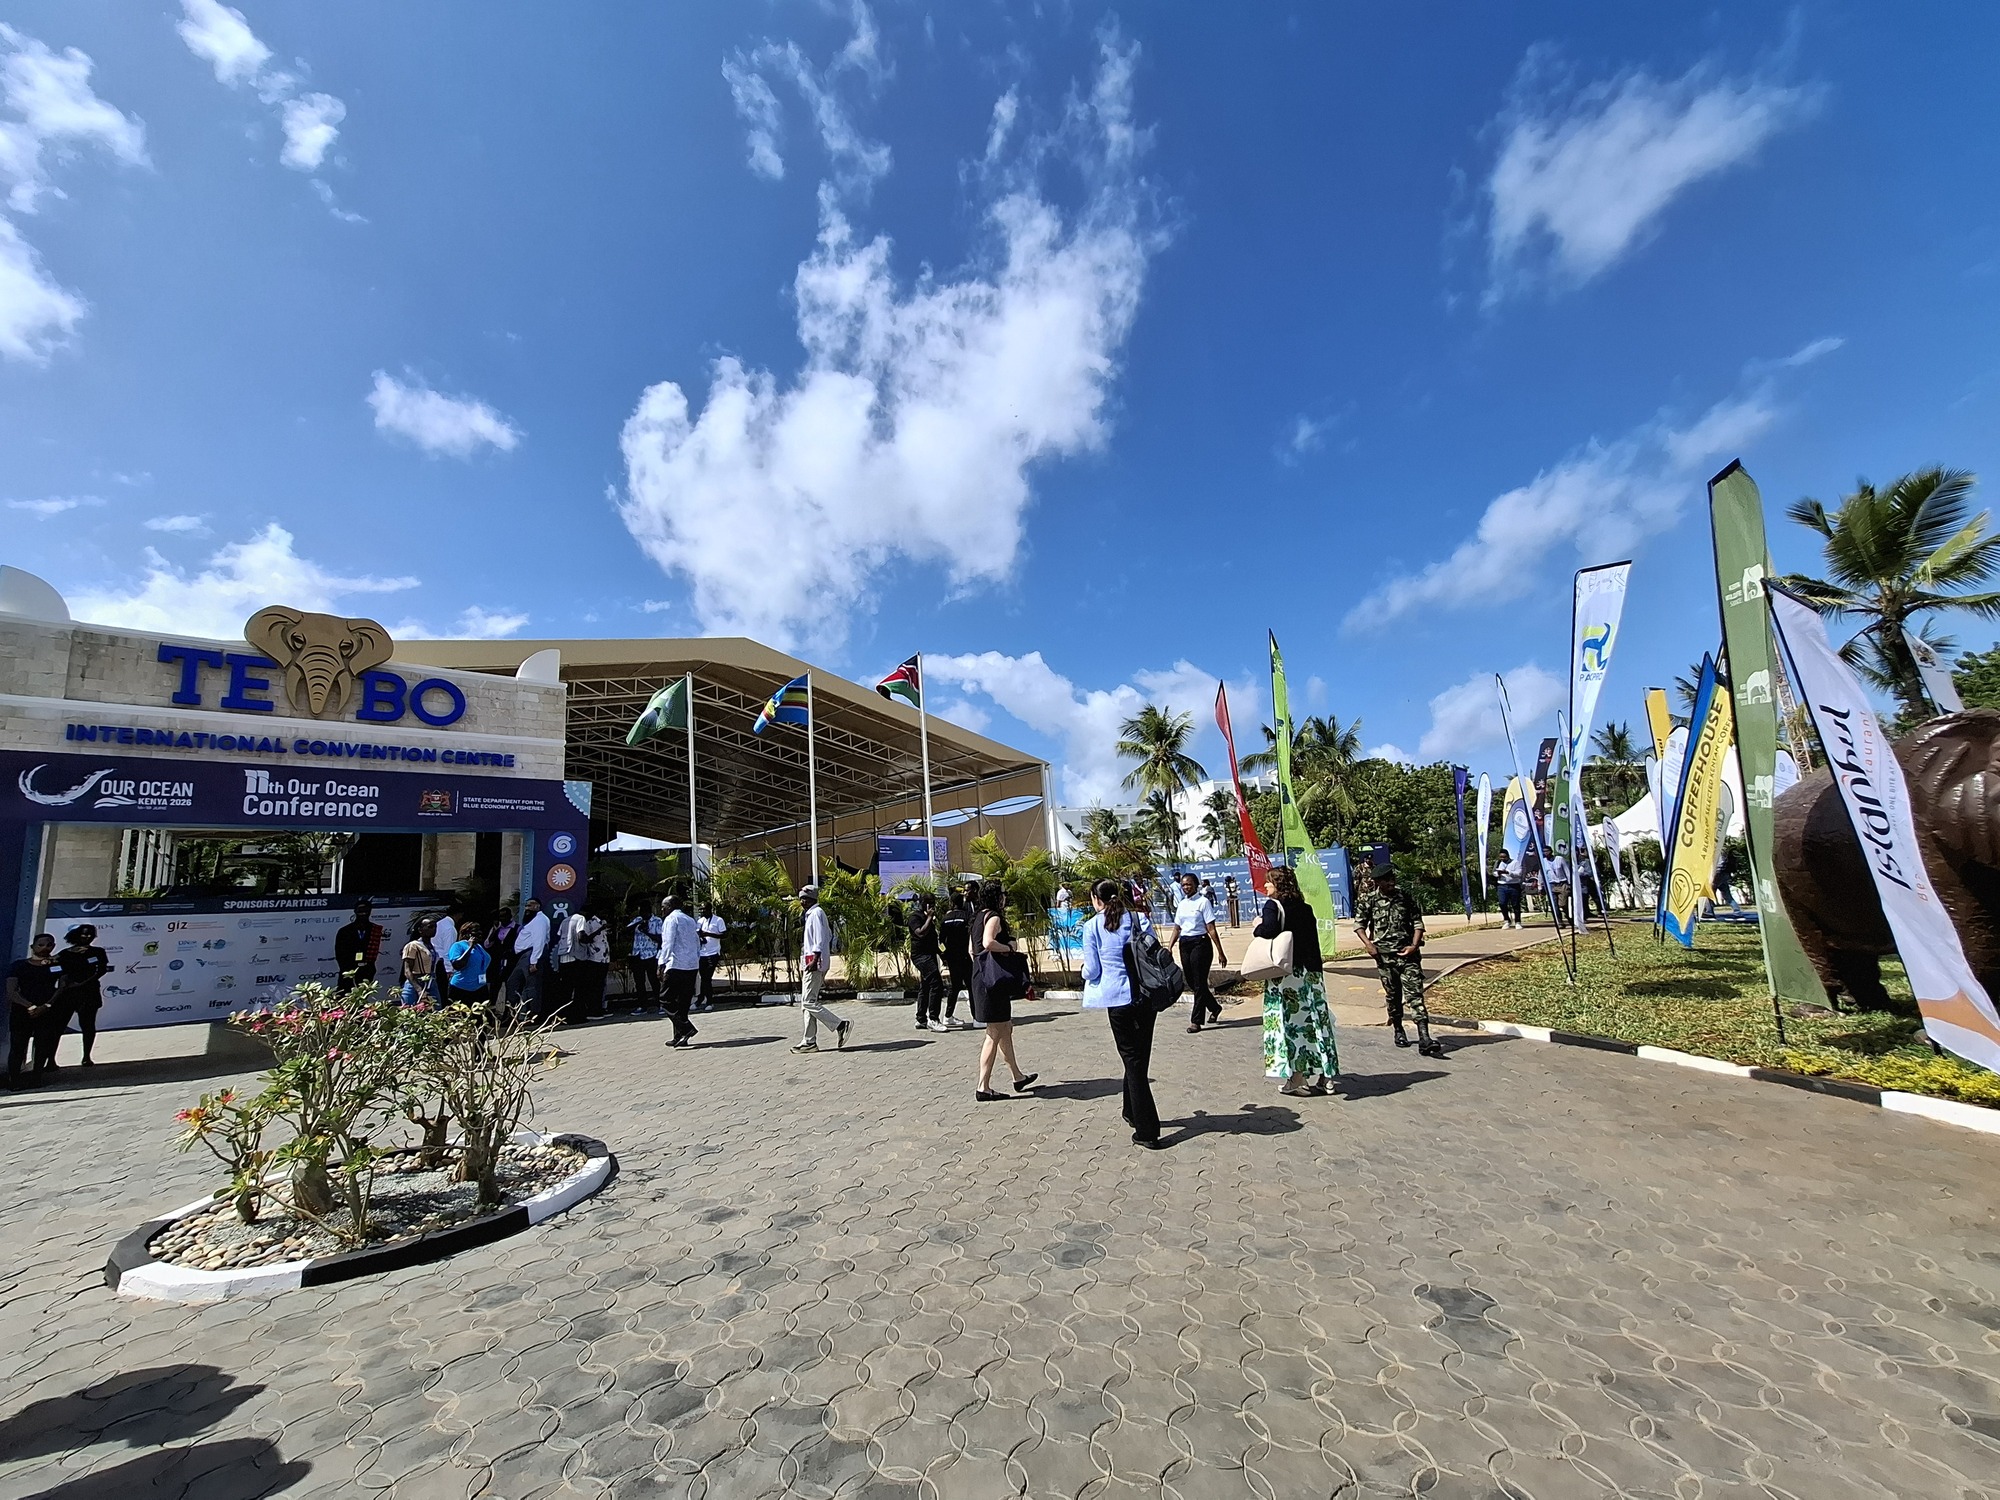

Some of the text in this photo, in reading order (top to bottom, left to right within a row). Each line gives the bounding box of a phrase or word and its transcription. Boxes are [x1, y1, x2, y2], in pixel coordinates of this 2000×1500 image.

[66, 724, 515, 767] INTERNATIONAL CONVENTION CENTRE
[1681, 698, 1723, 848] COFFEEHOUSE
[1709, 745, 1720, 778] KENYAN
[100, 779, 194, 797] OUR OCEAN
[287, 778, 320, 795] Our
[325, 780, 379, 798] Ocean
[1705, 779, 1714, 815] SELECTED
[138, 797, 192, 806] KENYA 2026
[243, 794, 378, 818] Conference
[1702, 829, 1710, 853] BLEND
[224, 898, 328, 910] SPONSORS/PARTNERS
[167, 920, 188, 933] giz
